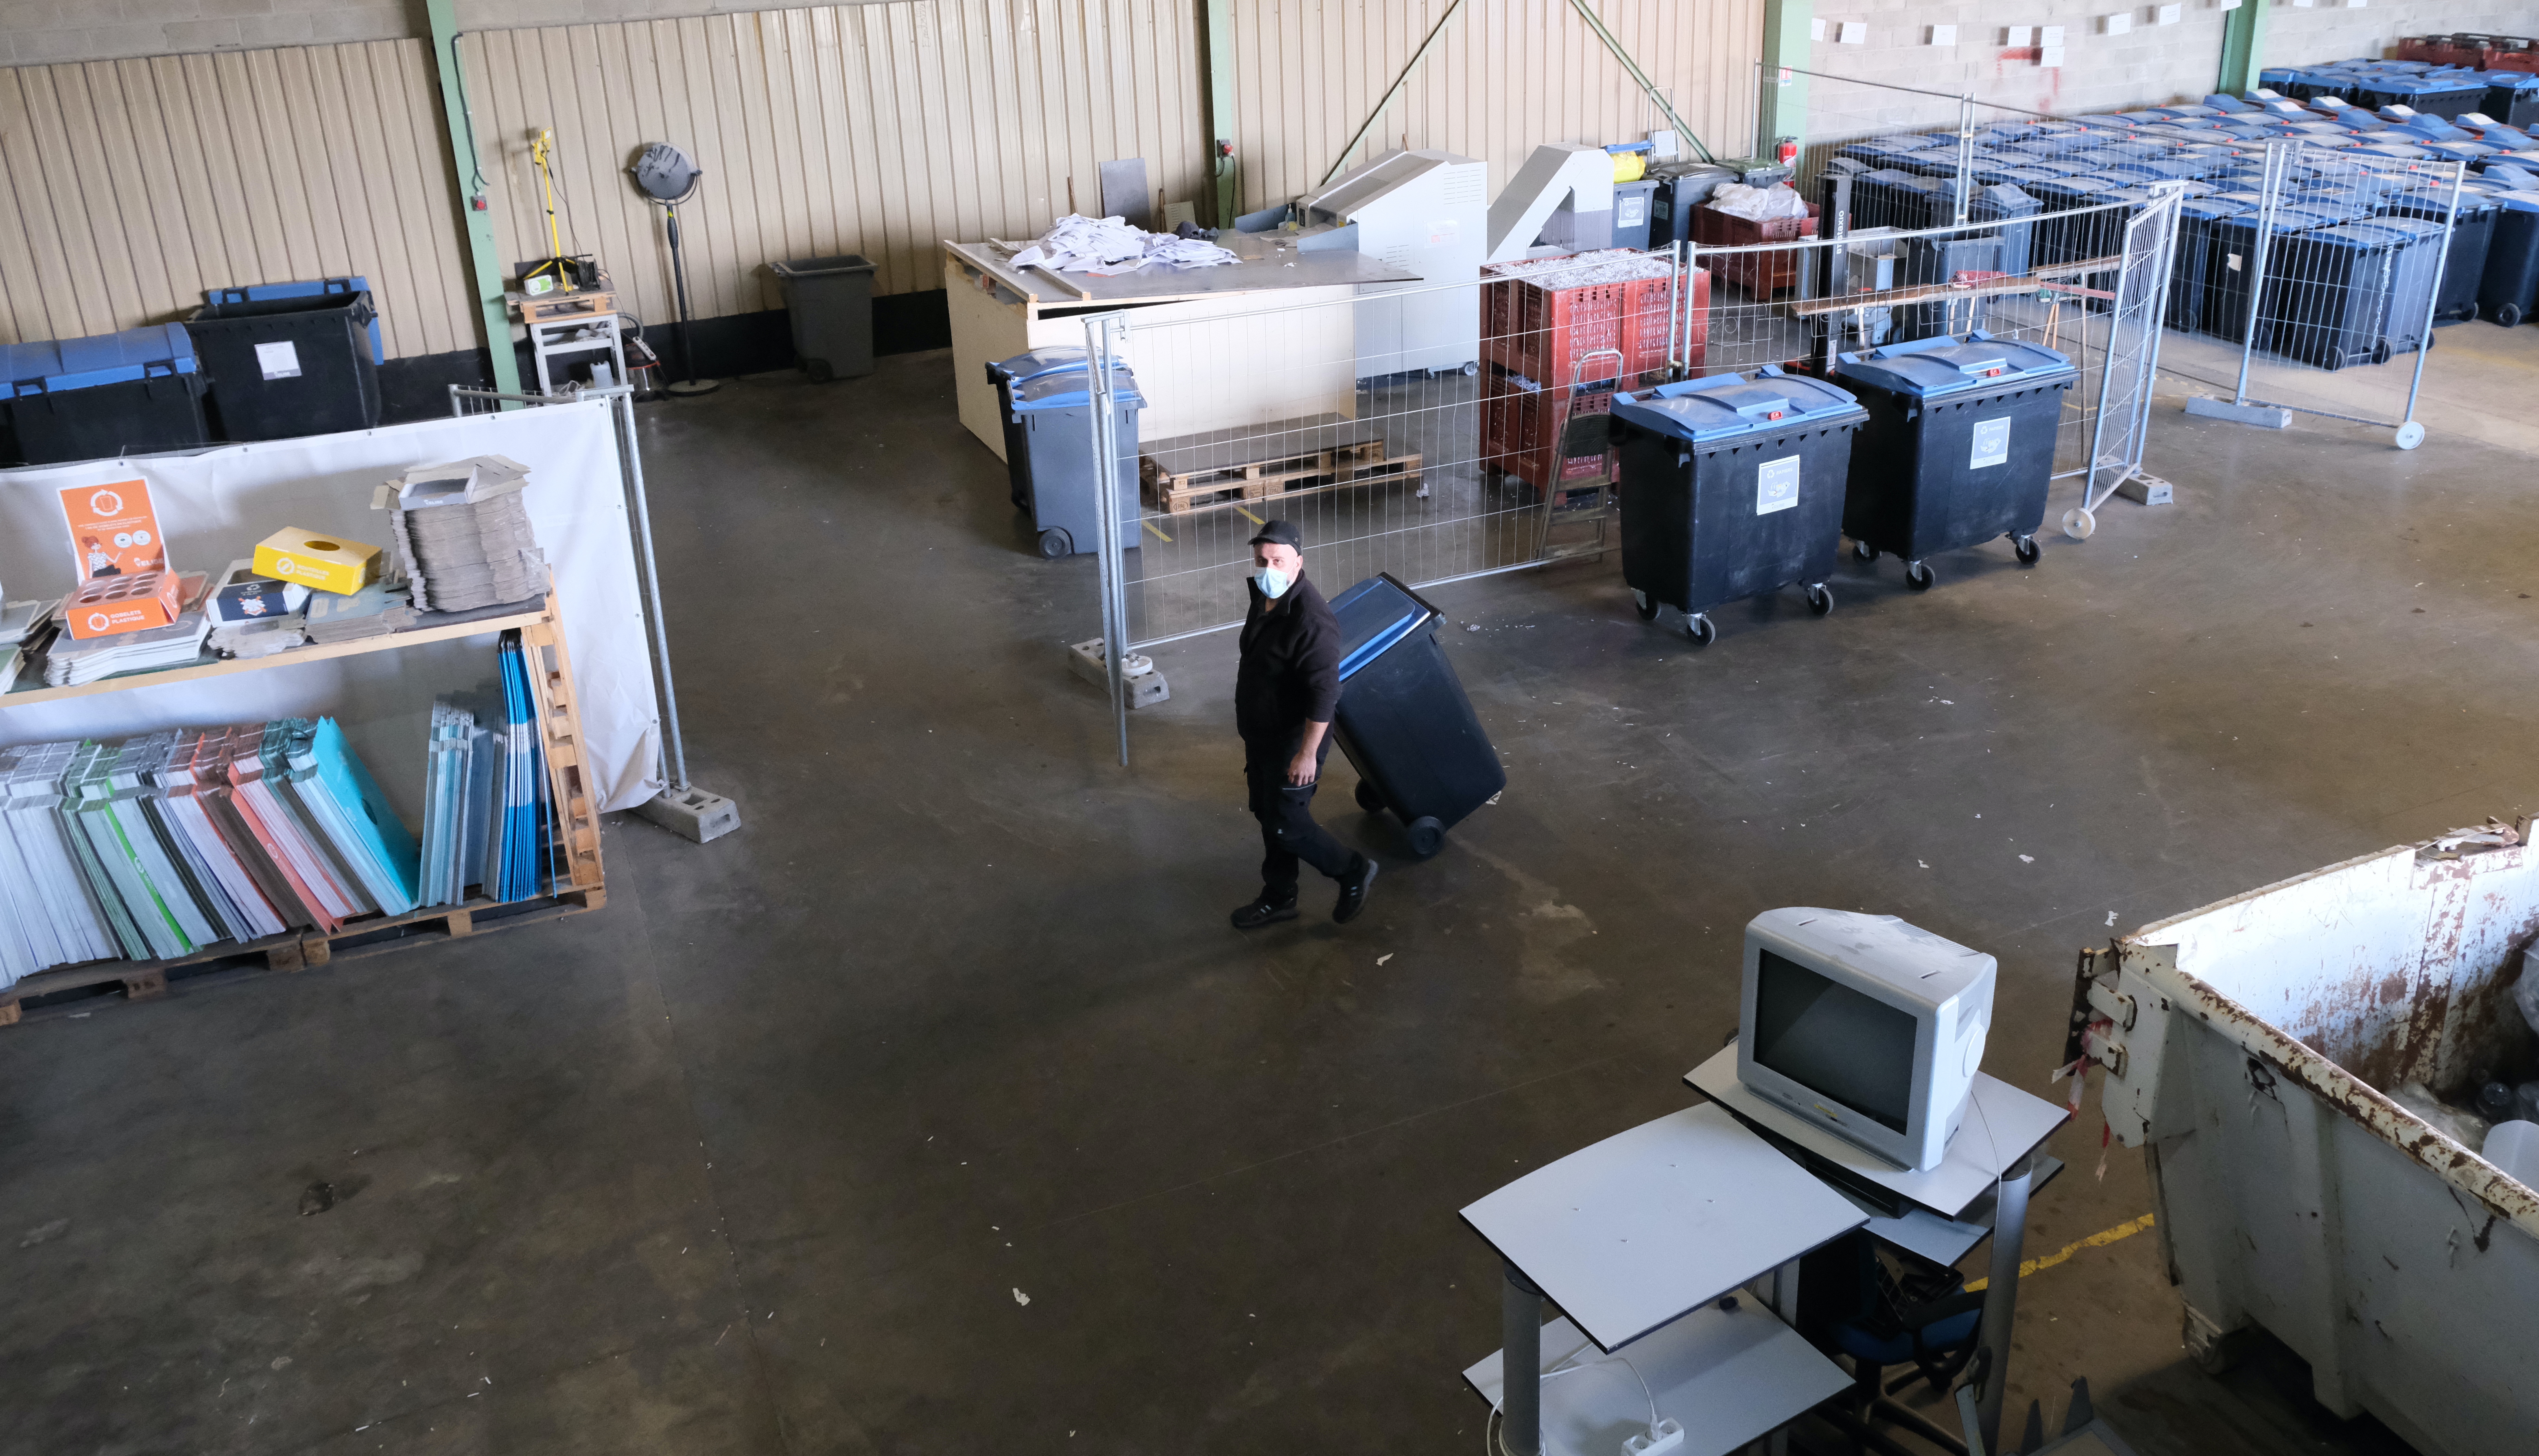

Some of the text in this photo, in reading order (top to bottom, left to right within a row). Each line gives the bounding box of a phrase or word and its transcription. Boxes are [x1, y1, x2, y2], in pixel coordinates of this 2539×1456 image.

[1836, 244, 1842, 254] BT
[1776, 467, 1793, 475] PAPIERS
[110, 610, 141, 618] GOBELETS
[112, 615, 144, 624] PLASTIQUE
